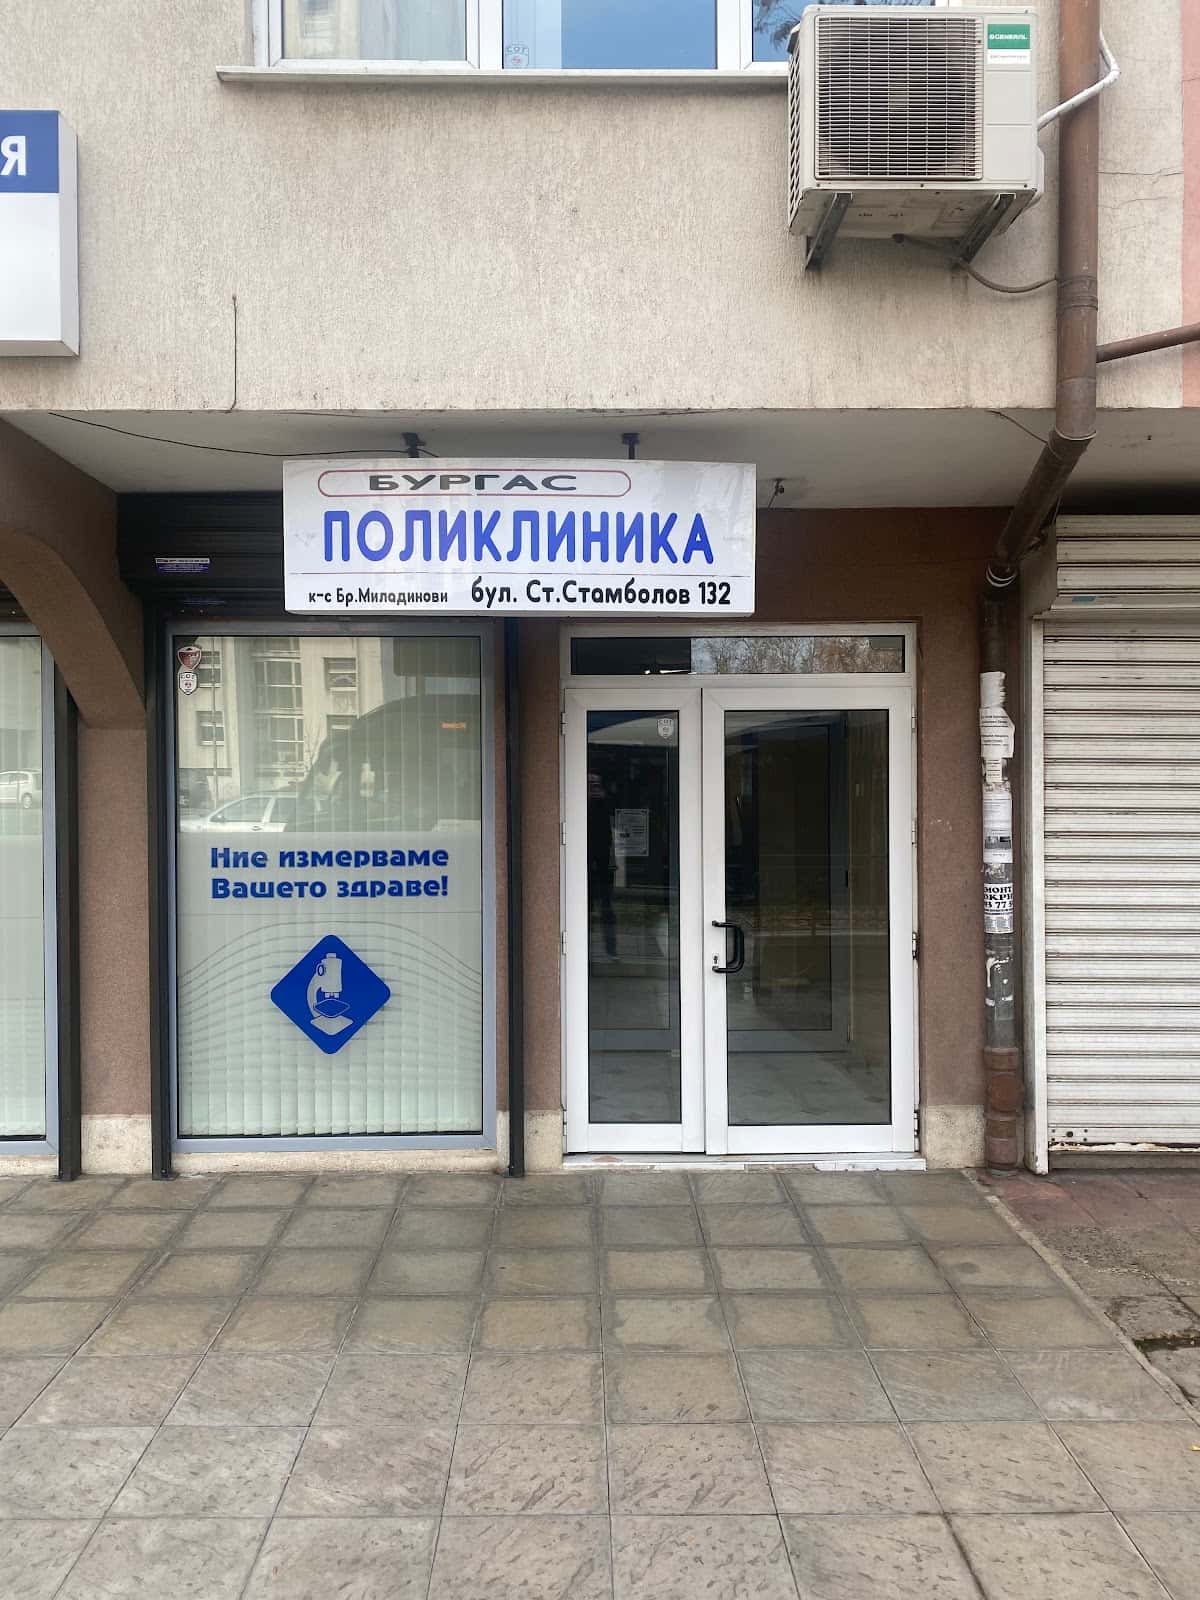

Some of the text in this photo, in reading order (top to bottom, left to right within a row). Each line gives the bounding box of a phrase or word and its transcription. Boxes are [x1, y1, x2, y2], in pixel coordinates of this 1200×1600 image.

[0, 135, 27, 177] Я
[369, 474, 577, 491] БУРГАС
[323, 509, 715, 566] ПОЛИКЛИНИКА
[308, 575, 731, 609] к-с Бр.Миладинови бул. Ст.Стамболов 132
[210, 847, 449, 869] Ние измерваме
[211, 875, 449, 899] Вашето здраве!
[995, 901, 1006, 909] 77
